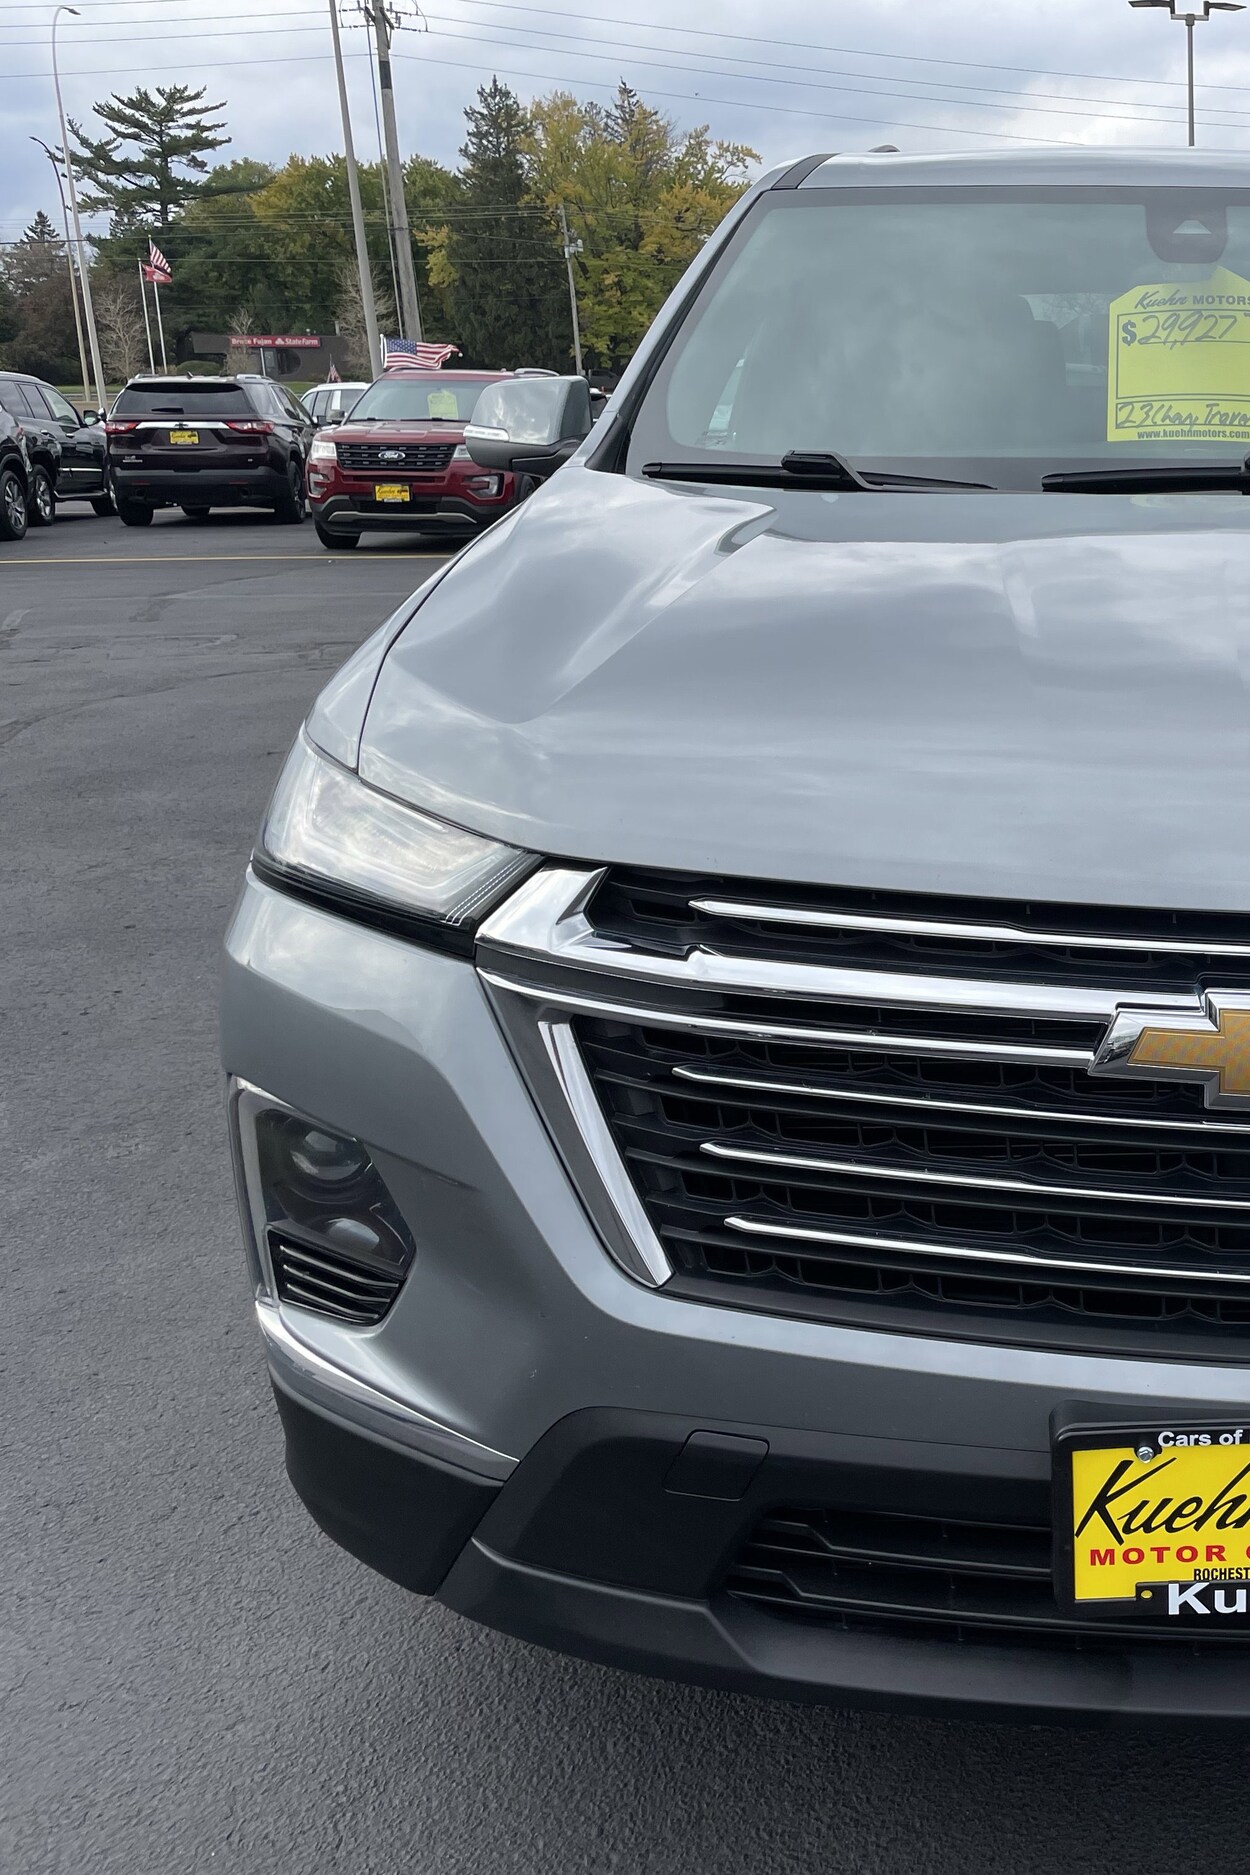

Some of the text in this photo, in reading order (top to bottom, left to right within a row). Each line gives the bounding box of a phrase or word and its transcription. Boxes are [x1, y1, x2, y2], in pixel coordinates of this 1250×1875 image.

[1135, 289, 1187, 310] Kuehn
[1137, 429, 1250, 440] www.kuehnmotors.com
[1158, 1431, 1211, 1448] Cars
[1219, 1429, 1243, 1446] of
[1090, 1545, 1227, 1566] MOTOR
